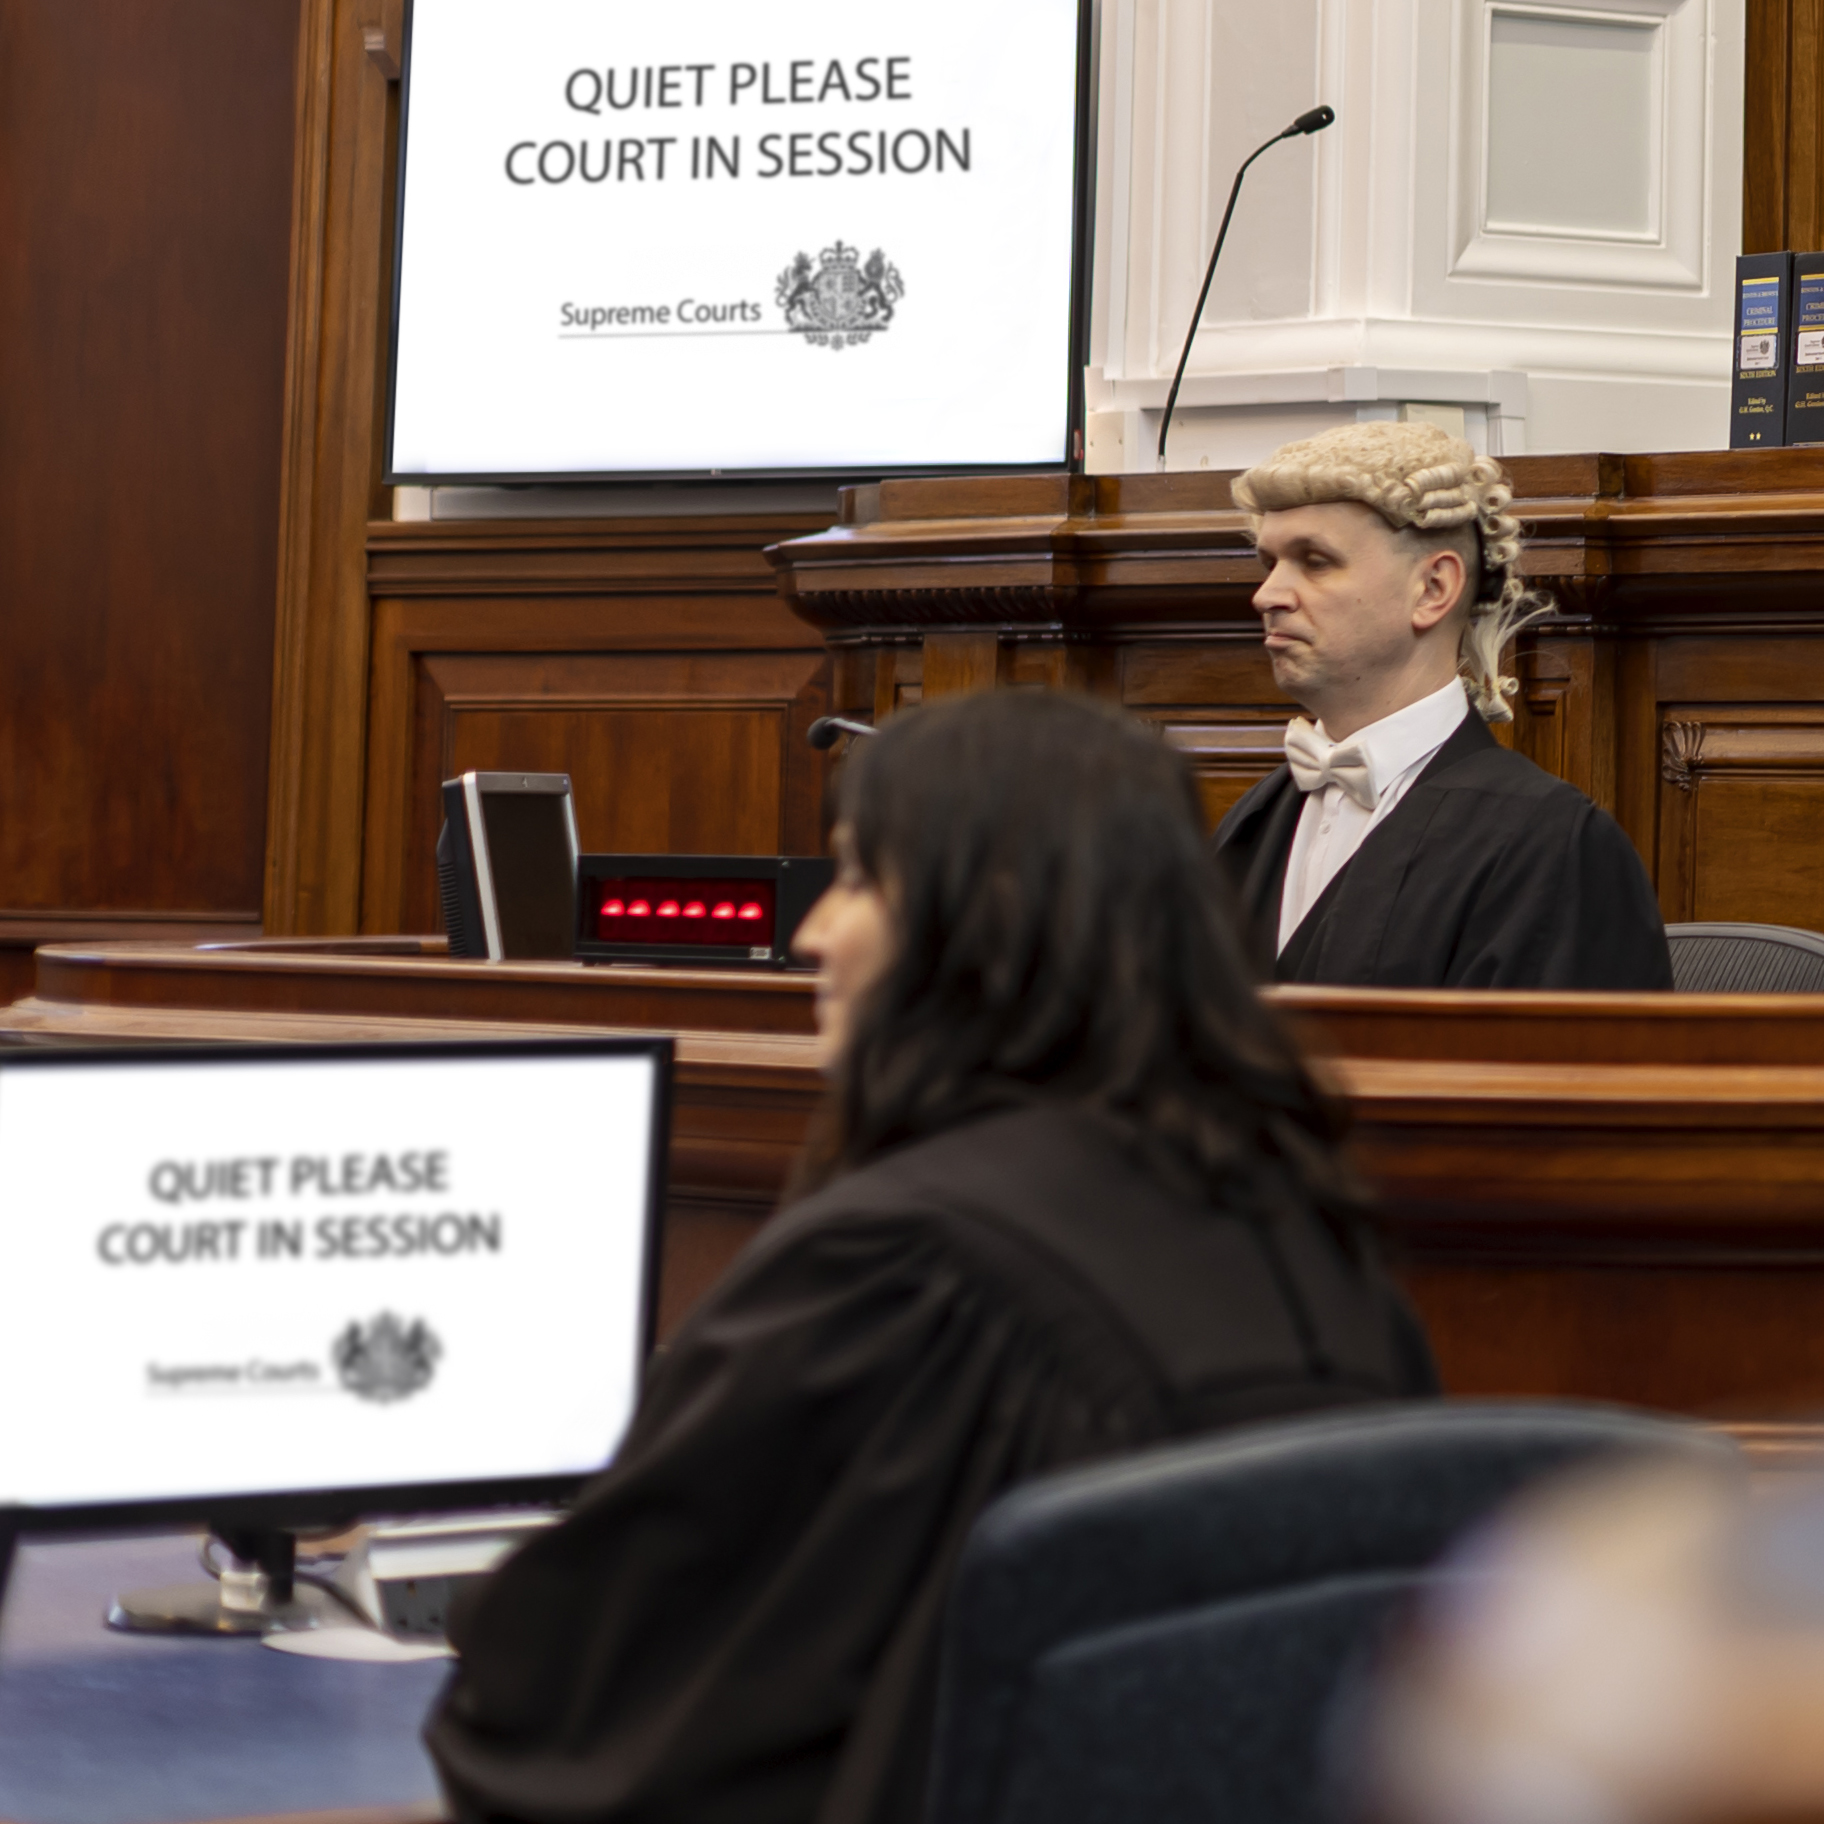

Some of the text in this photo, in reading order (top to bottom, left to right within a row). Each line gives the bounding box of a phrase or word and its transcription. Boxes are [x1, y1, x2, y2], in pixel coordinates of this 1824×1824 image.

[565, 56, 912, 116] QUIET PLEASE
[504, 127, 972, 186] COURT IN SESSION
[559, 298, 762, 330] Supreme Courts
[148, 1150, 448, 1205] QUIET PLEASE
[97, 1212, 503, 1265] COURT IN SESSION
